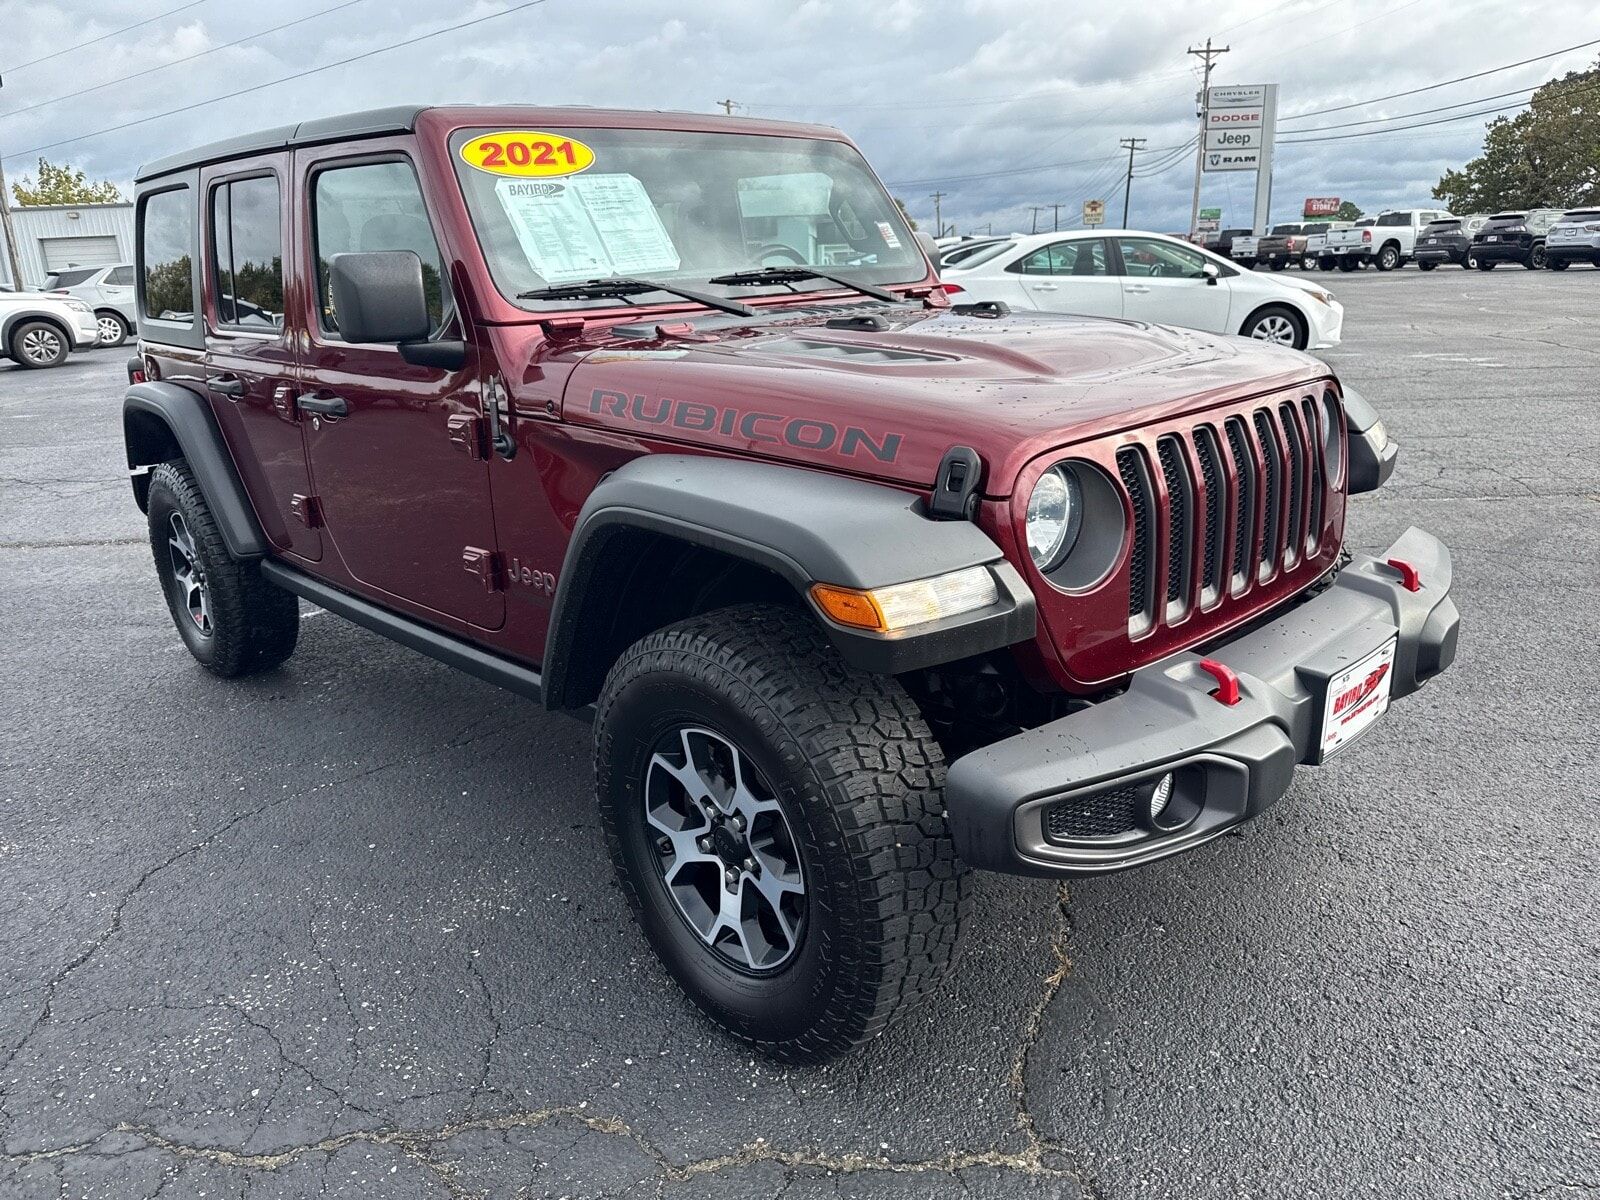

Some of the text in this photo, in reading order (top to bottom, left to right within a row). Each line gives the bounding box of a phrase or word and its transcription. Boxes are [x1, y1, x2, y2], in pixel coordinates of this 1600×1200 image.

[1211, 113, 1259, 123] DODGE
[1217, 131, 1251, 147] Jeep
[479, 141, 577, 167] 2021
[1222, 155, 1257, 163] RAM
[588, 387, 905, 464] RUBICON
[507, 557, 556, 597] Jeep
